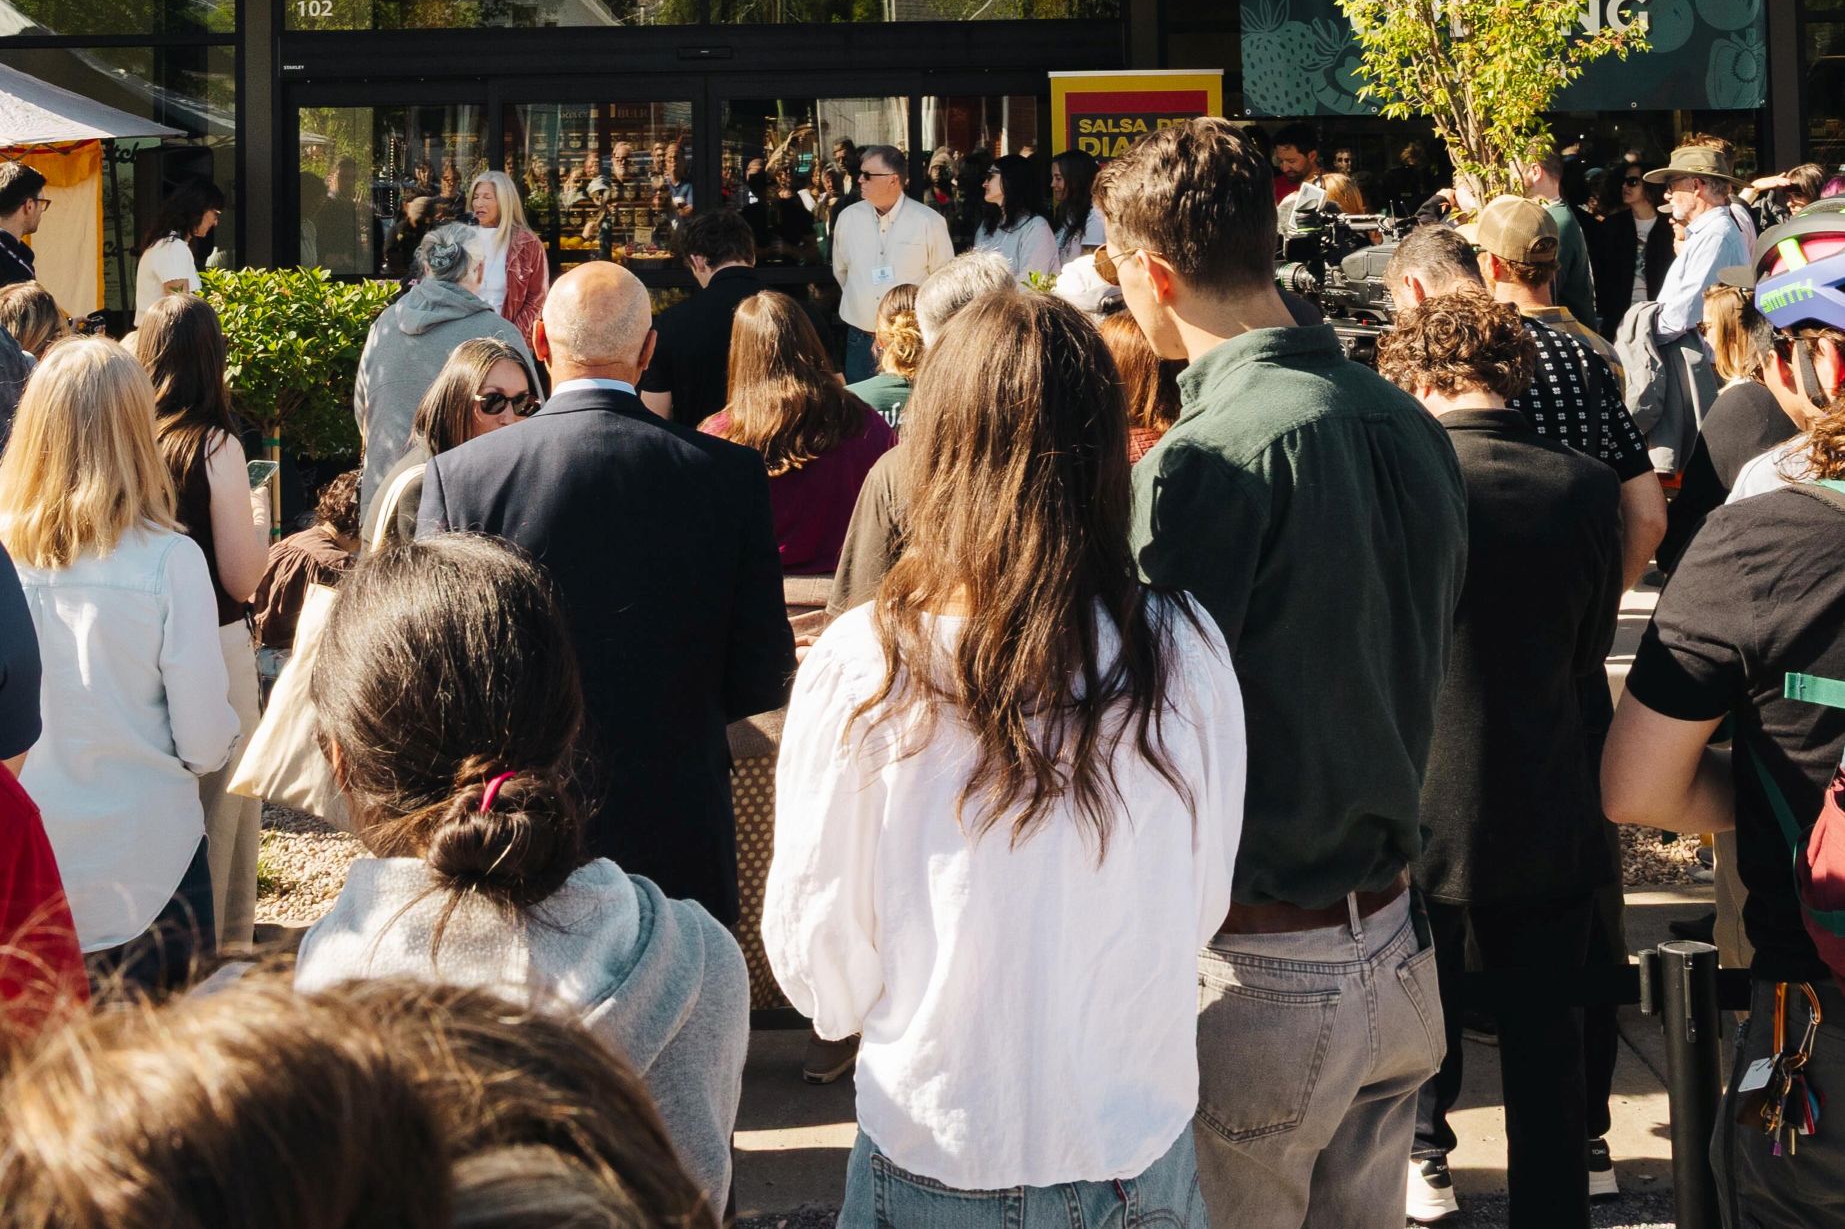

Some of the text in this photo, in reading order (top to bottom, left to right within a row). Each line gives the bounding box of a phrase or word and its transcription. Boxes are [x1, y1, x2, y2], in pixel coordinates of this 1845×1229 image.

[297, 0, 334, 17] 102
[1079, 118, 1187, 133] SALSA DE
[1078, 136, 1140, 157] DIA
[1759, 278, 1815, 314] SMITH
